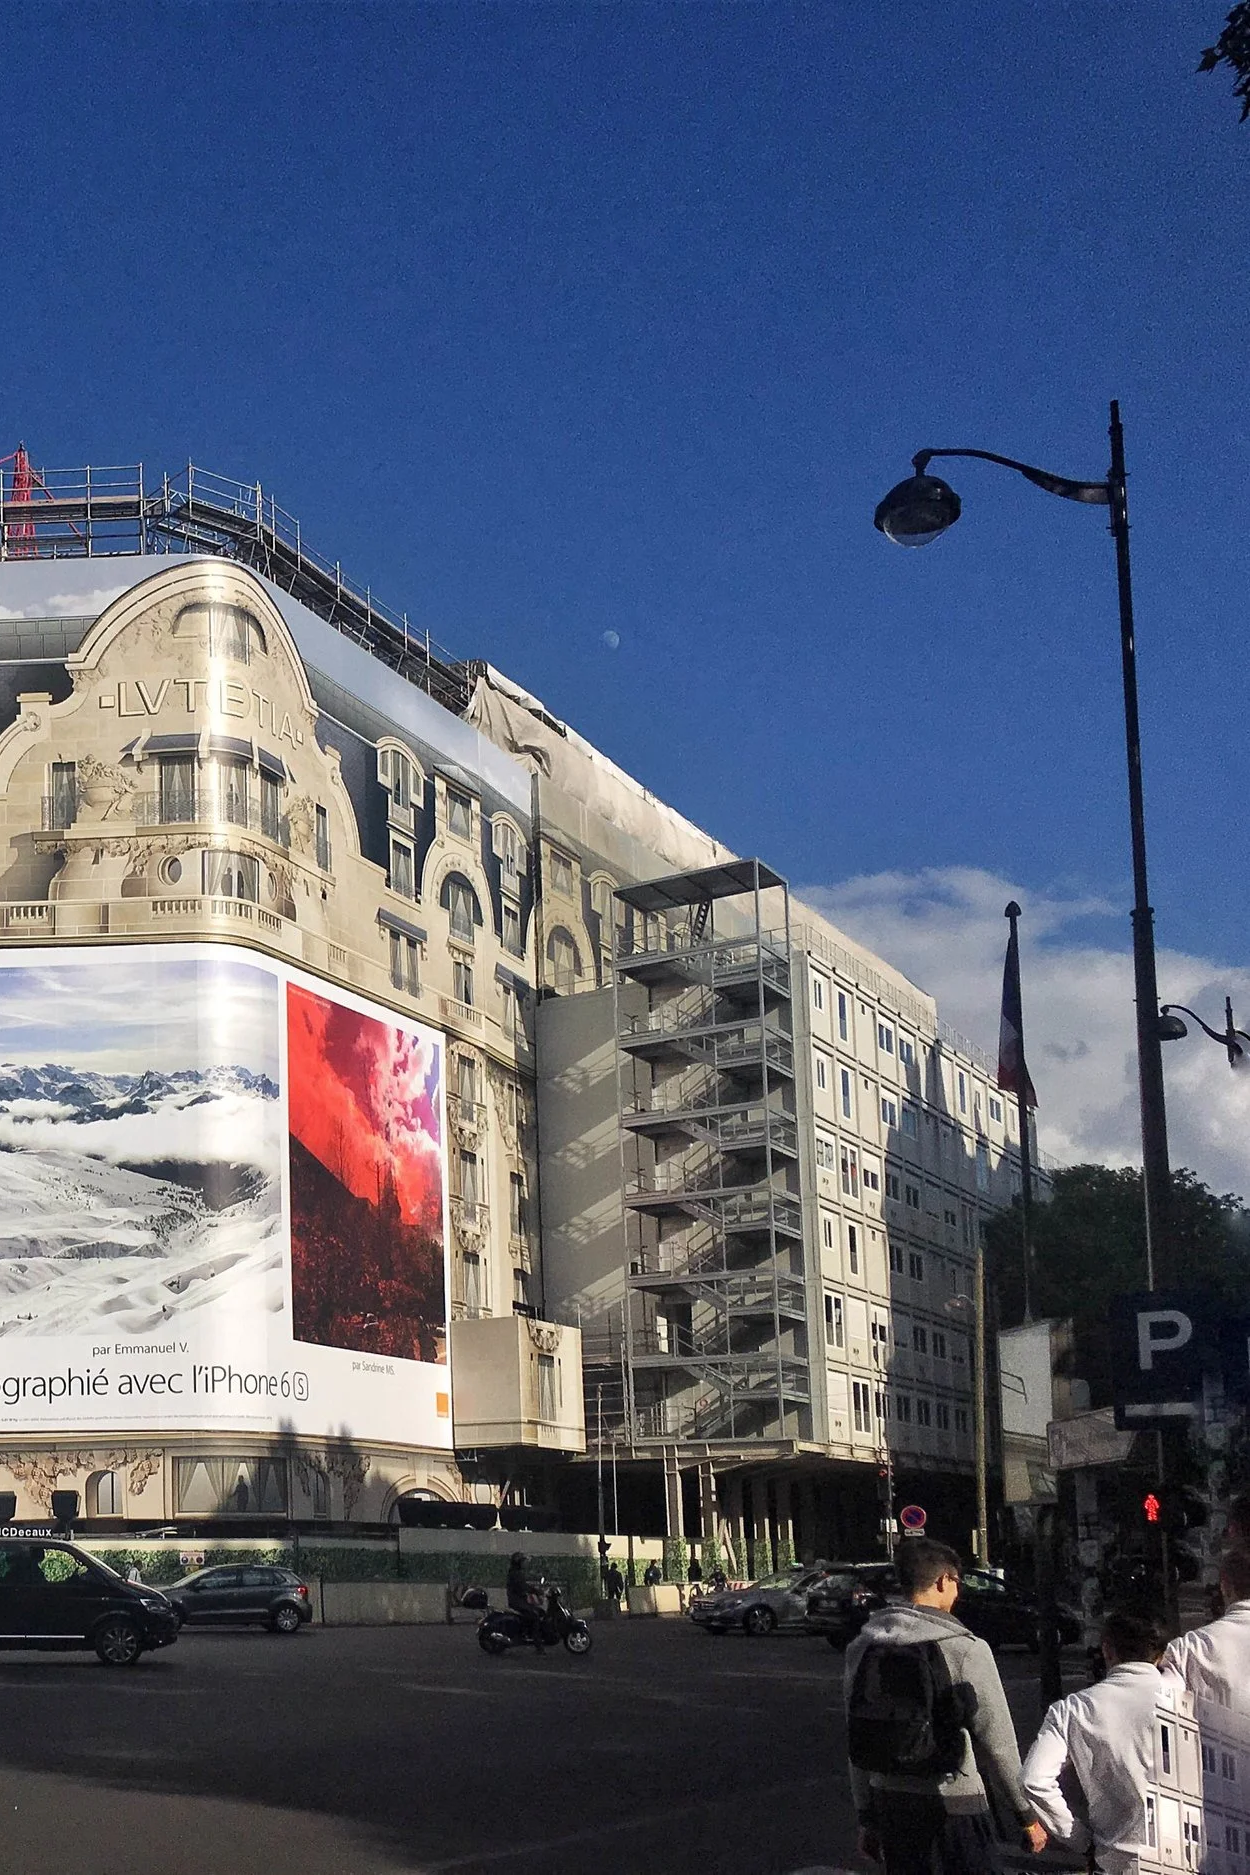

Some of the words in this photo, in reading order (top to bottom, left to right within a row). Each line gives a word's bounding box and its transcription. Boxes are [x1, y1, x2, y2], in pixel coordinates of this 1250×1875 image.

[117, 679, 298, 750] LVTETIA
[92, 1346, 111, 1357] par
[115, 1342, 176, 1355] Emmanuel
[179, 1342, 189, 1353] V.
[1137, 1310, 1192, 1371] P
[352, 1361, 362, 1372] par
[362, 1360, 385, 1374] Sandrine
[118, 1372, 183, 1395] avec
